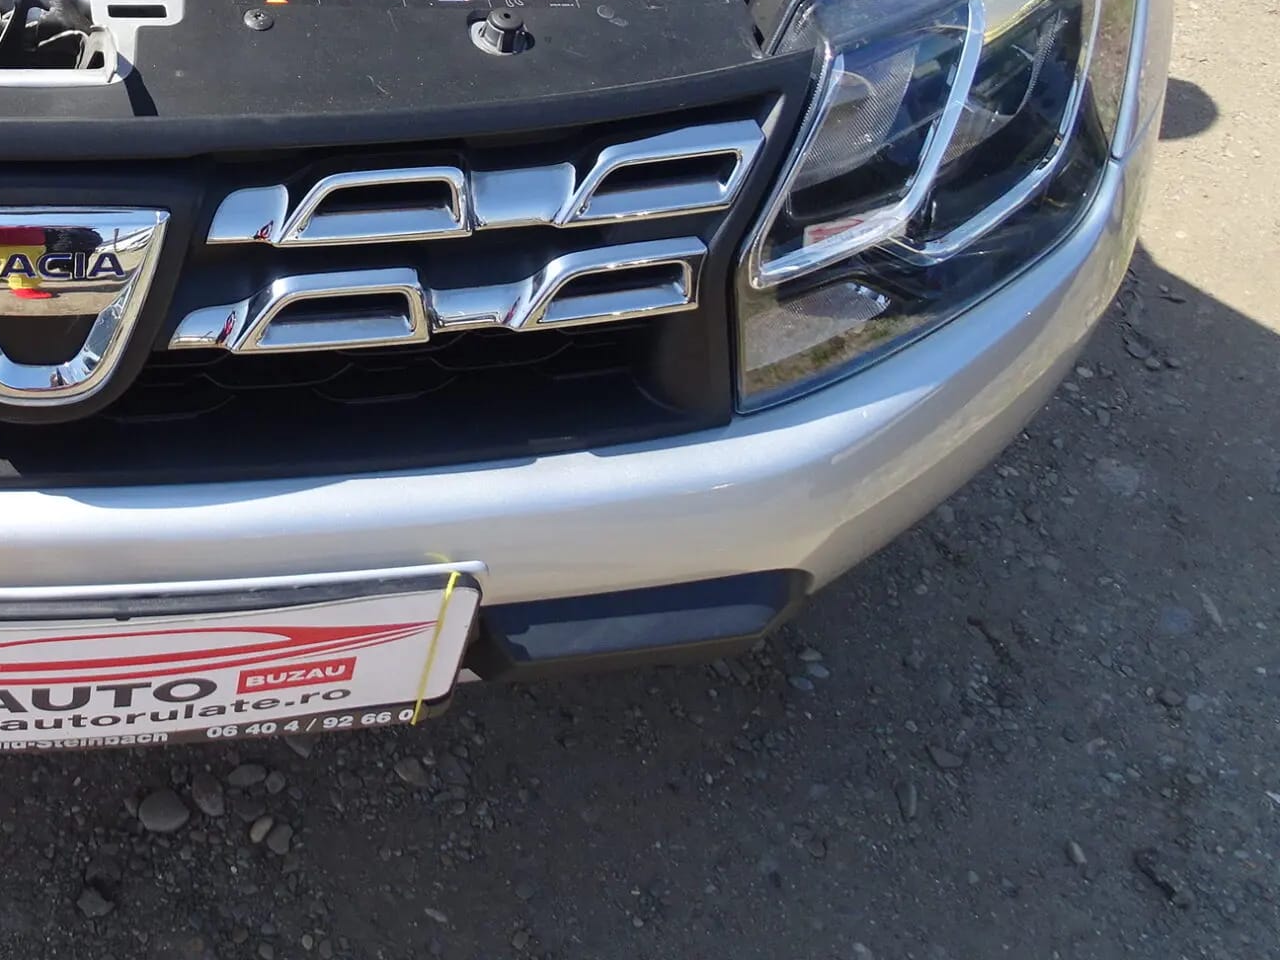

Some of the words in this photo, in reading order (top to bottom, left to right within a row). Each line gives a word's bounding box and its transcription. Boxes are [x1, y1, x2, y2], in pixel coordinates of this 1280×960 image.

[245, 664, 346, 687] BUZAU
[245, 721, 277, 735] 40
[322, 714, 353, 729] 92
[361, 711, 392, 725] 66
